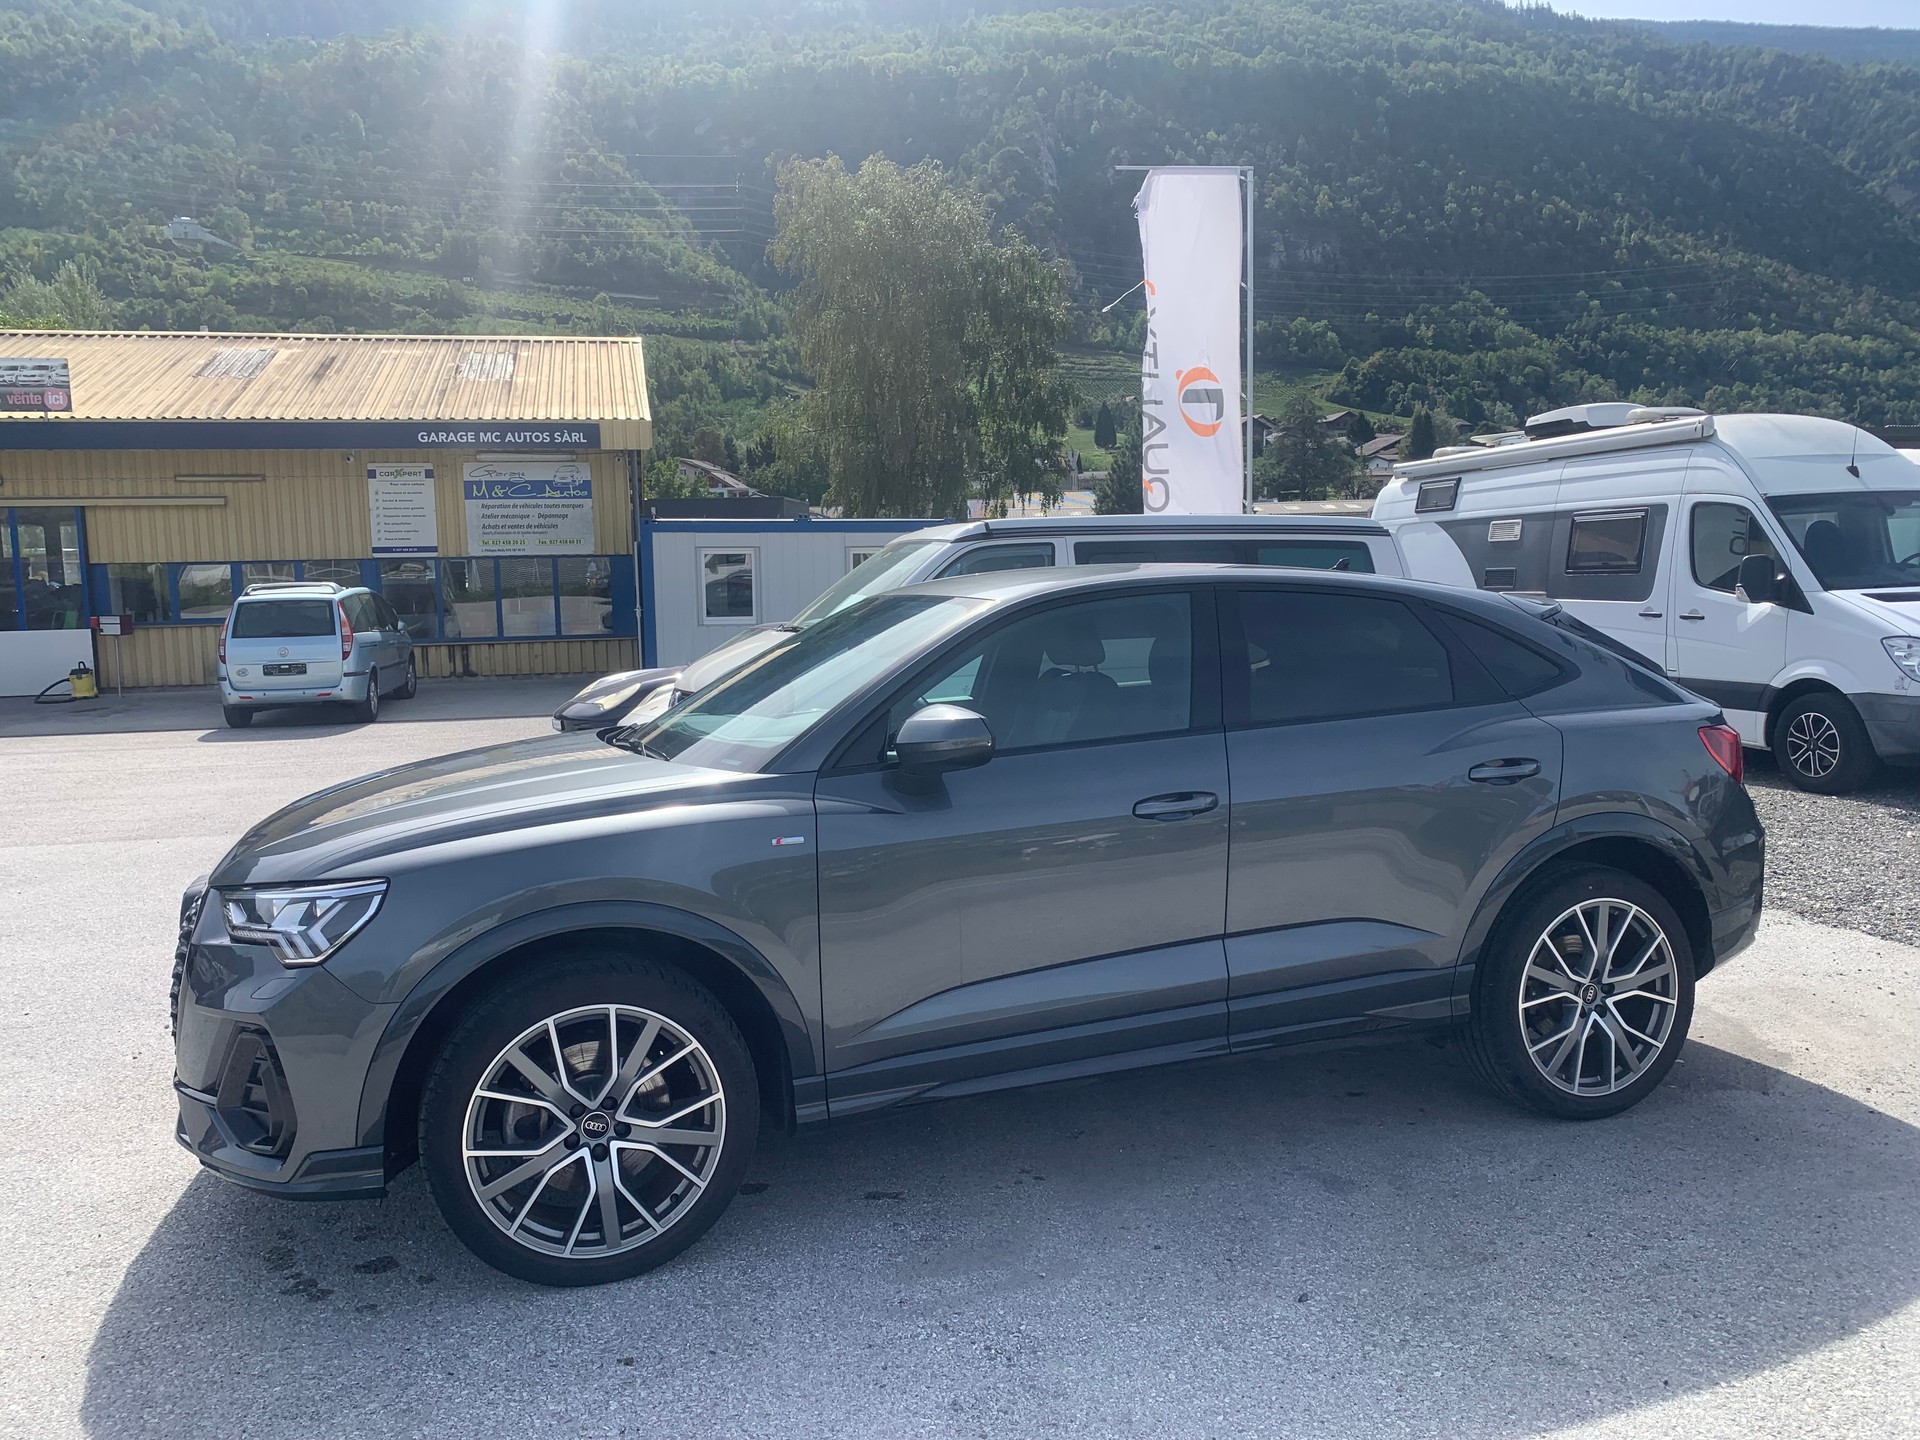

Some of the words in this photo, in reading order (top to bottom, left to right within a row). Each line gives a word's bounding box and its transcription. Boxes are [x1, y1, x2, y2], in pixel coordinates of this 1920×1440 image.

[6, 392, 42, 405] vente
[48, 391, 63, 405] ici
[417, 431, 475, 443] GARAGE
[479, 431, 501, 443] MC
[504, 431, 551, 443] AUTOS
[469, 463, 527, 483] Garage
[473, 478, 489, 499] M
[492, 484, 509, 497] &
[507, 483, 537, 497] C
[536, 483, 589, 498] Autos
[480, 502, 511, 510] Réparation
[560, 502, 584, 510] marques
[480, 512, 500, 520] Atelier
[500, 512, 530, 520] mécanique
[537, 511, 569, 520] Dépannage
[525, 522, 533, 530] de
